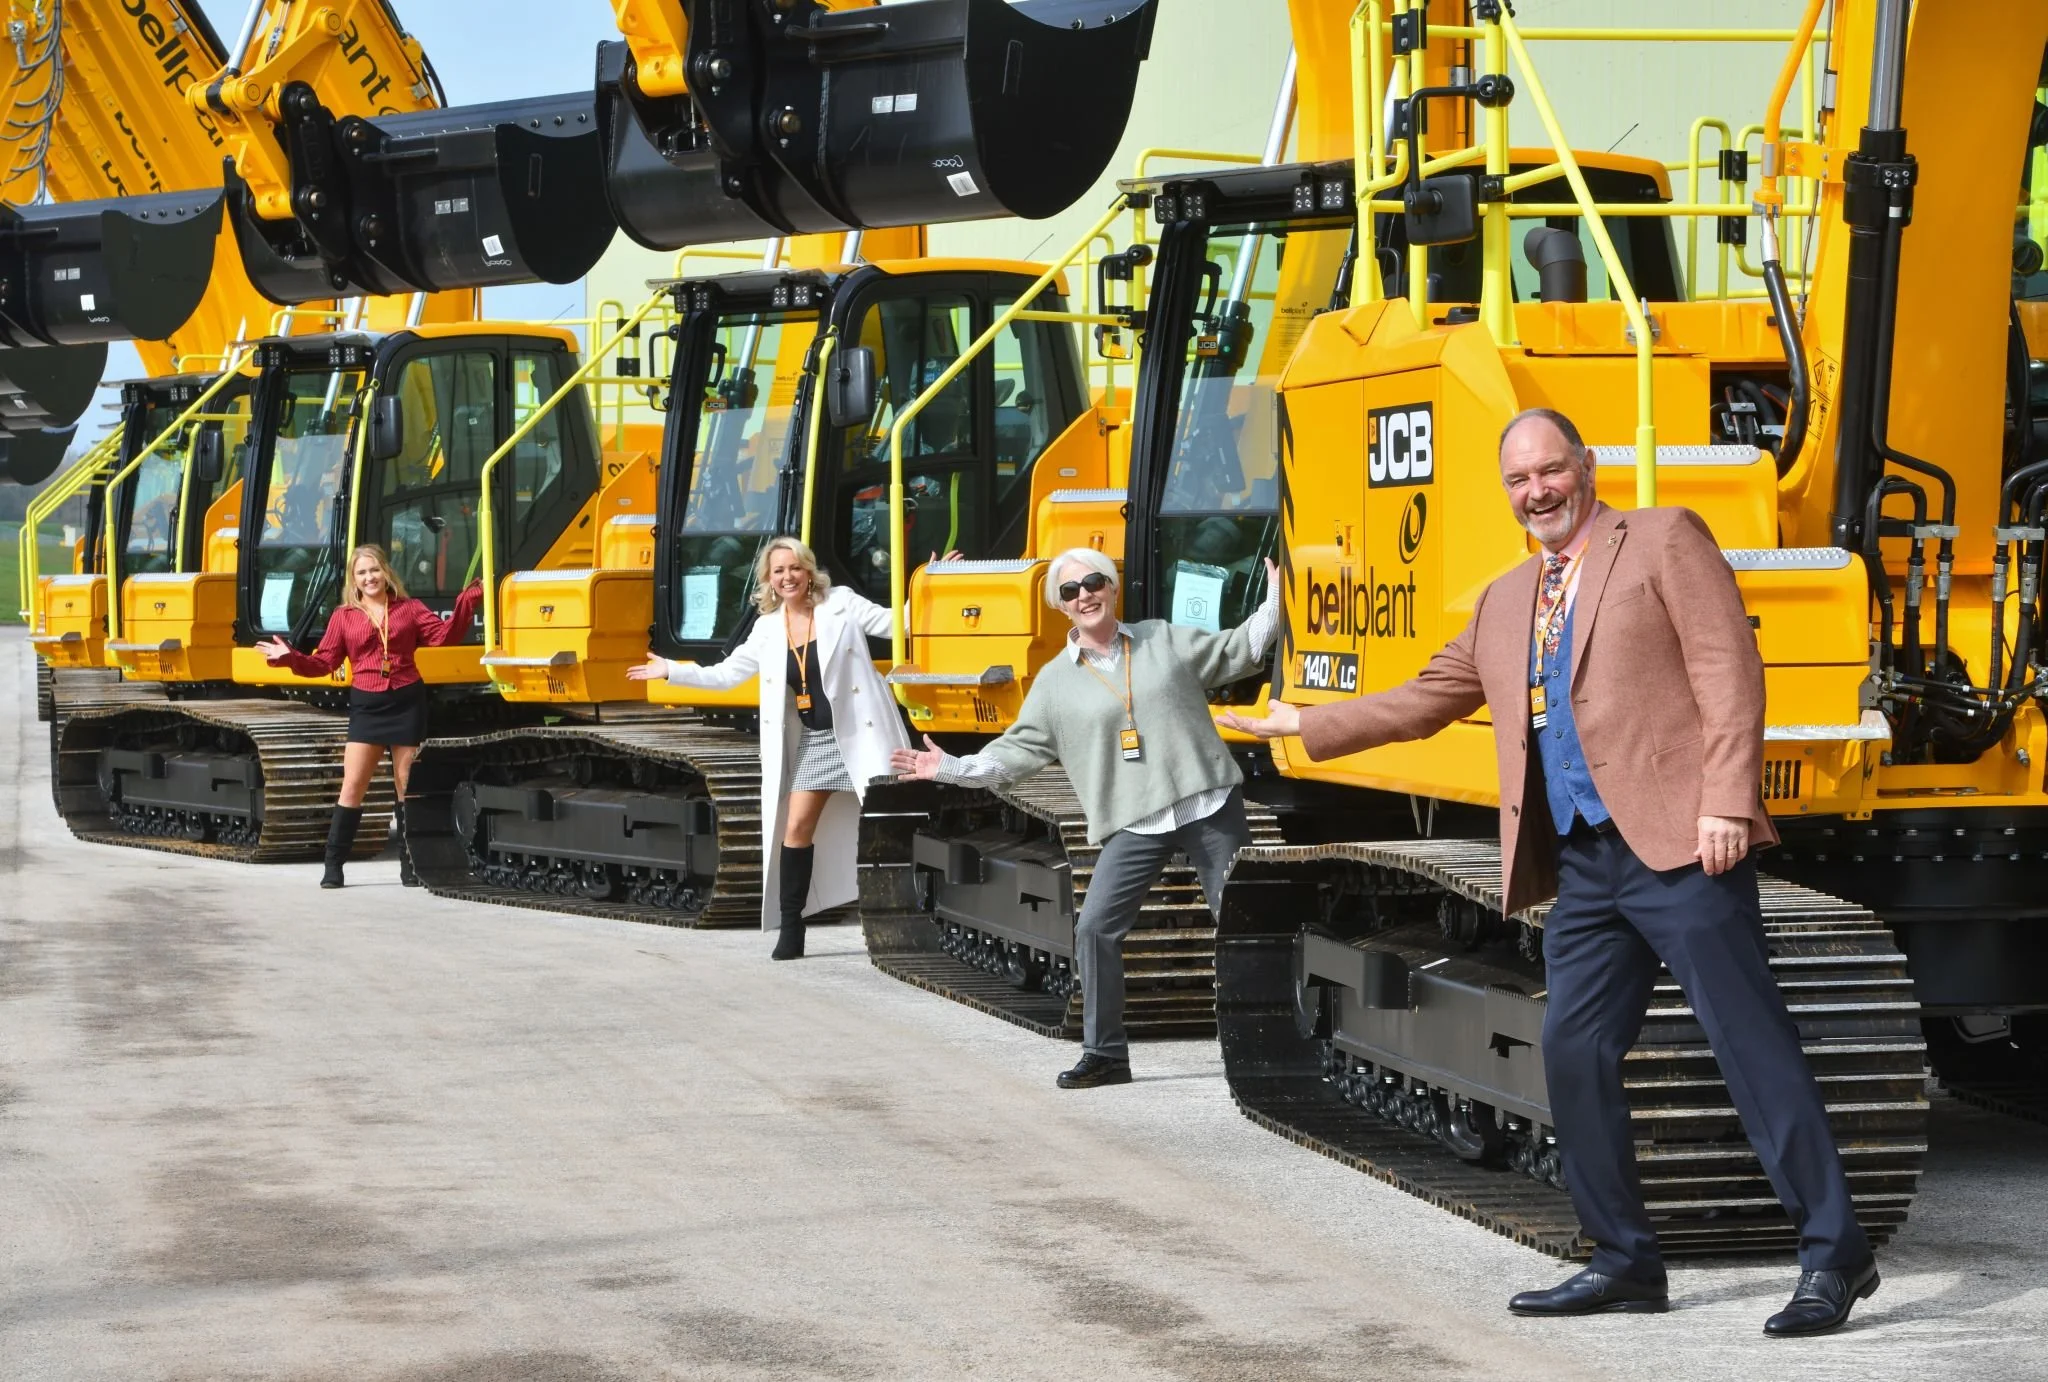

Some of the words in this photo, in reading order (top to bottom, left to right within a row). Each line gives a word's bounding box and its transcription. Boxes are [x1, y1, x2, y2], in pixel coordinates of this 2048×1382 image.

[1199, 341, 1217, 349] JCB
[1369, 410, 1433, 482] JCB
[1307, 566, 1416, 650] bellplant
[1304, 654, 1340, 688] 140X
[1340, 664, 1356, 690] LC
